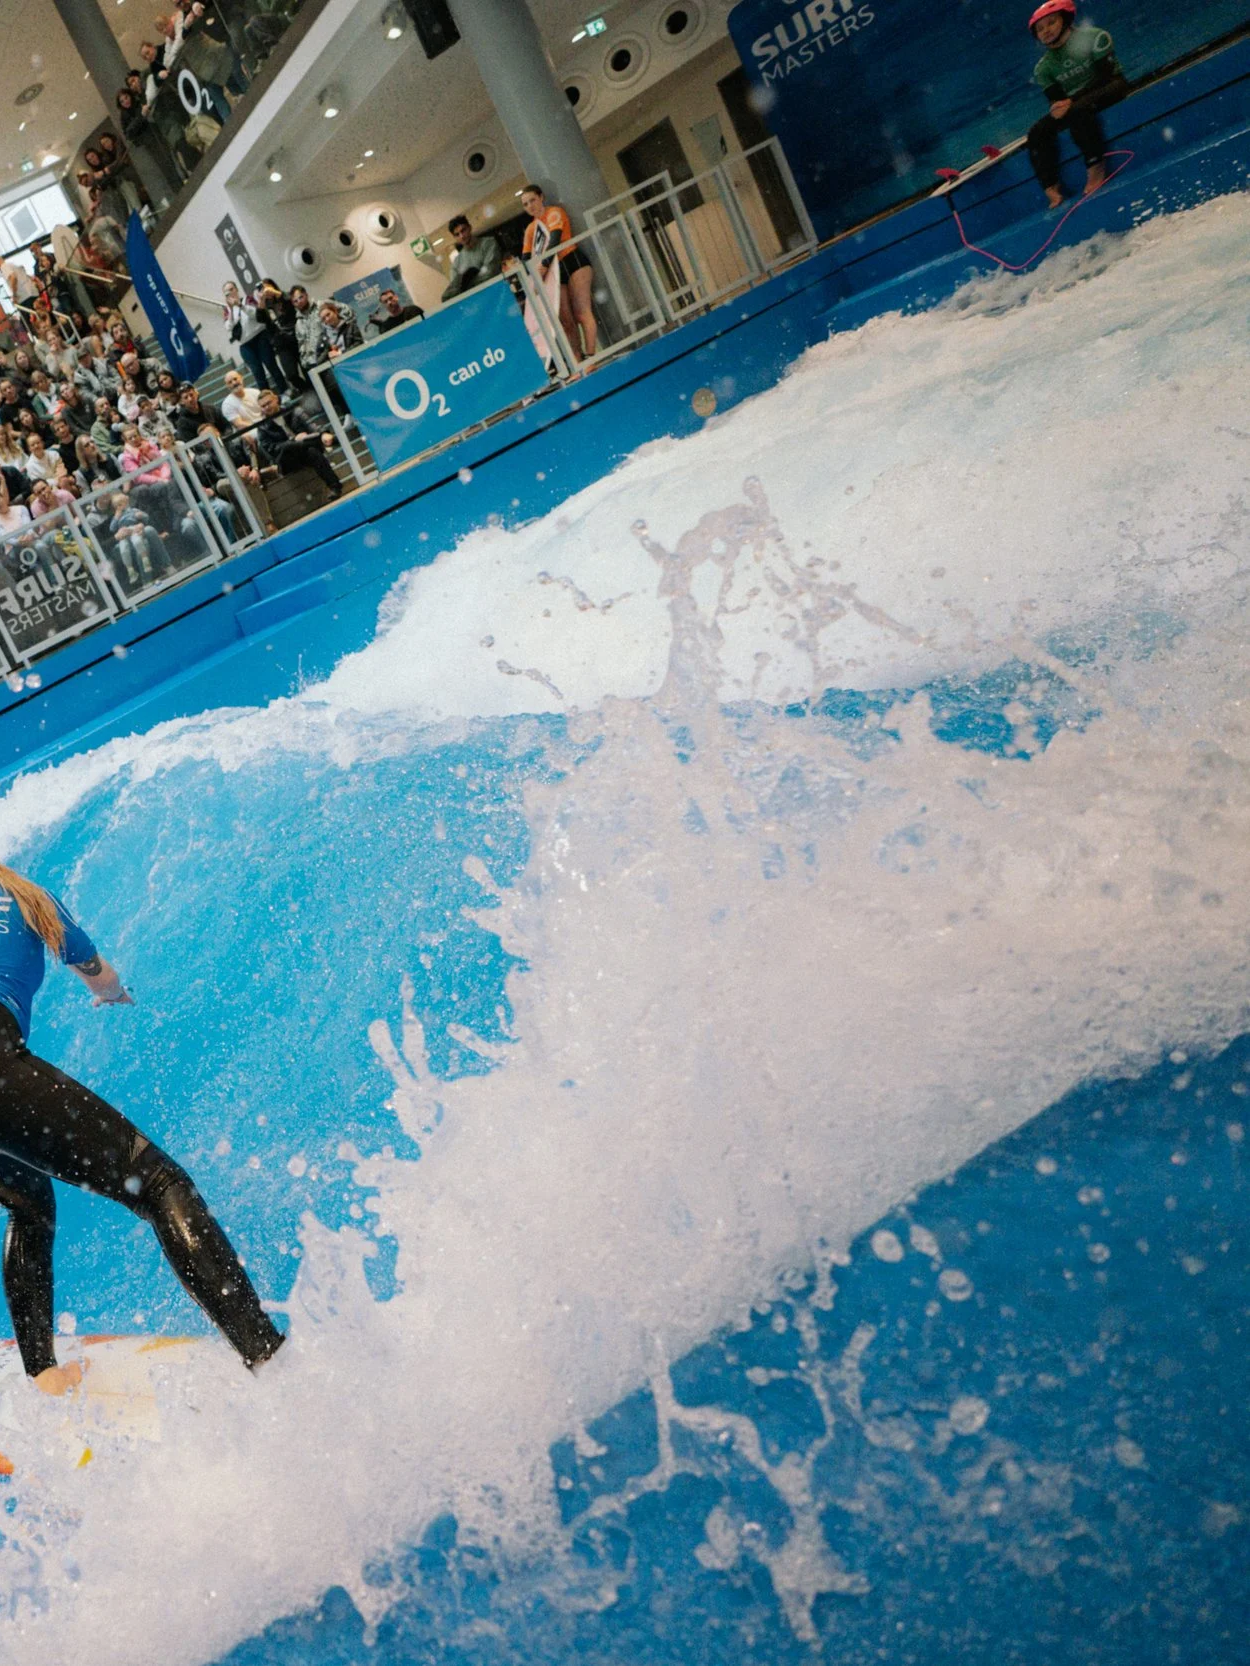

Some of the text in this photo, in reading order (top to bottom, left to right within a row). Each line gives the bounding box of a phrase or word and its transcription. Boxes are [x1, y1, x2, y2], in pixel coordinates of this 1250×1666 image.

[761, 4, 875, 88] MASTERS
[449, 361, 482, 386] can
[483, 347, 506, 368] do
